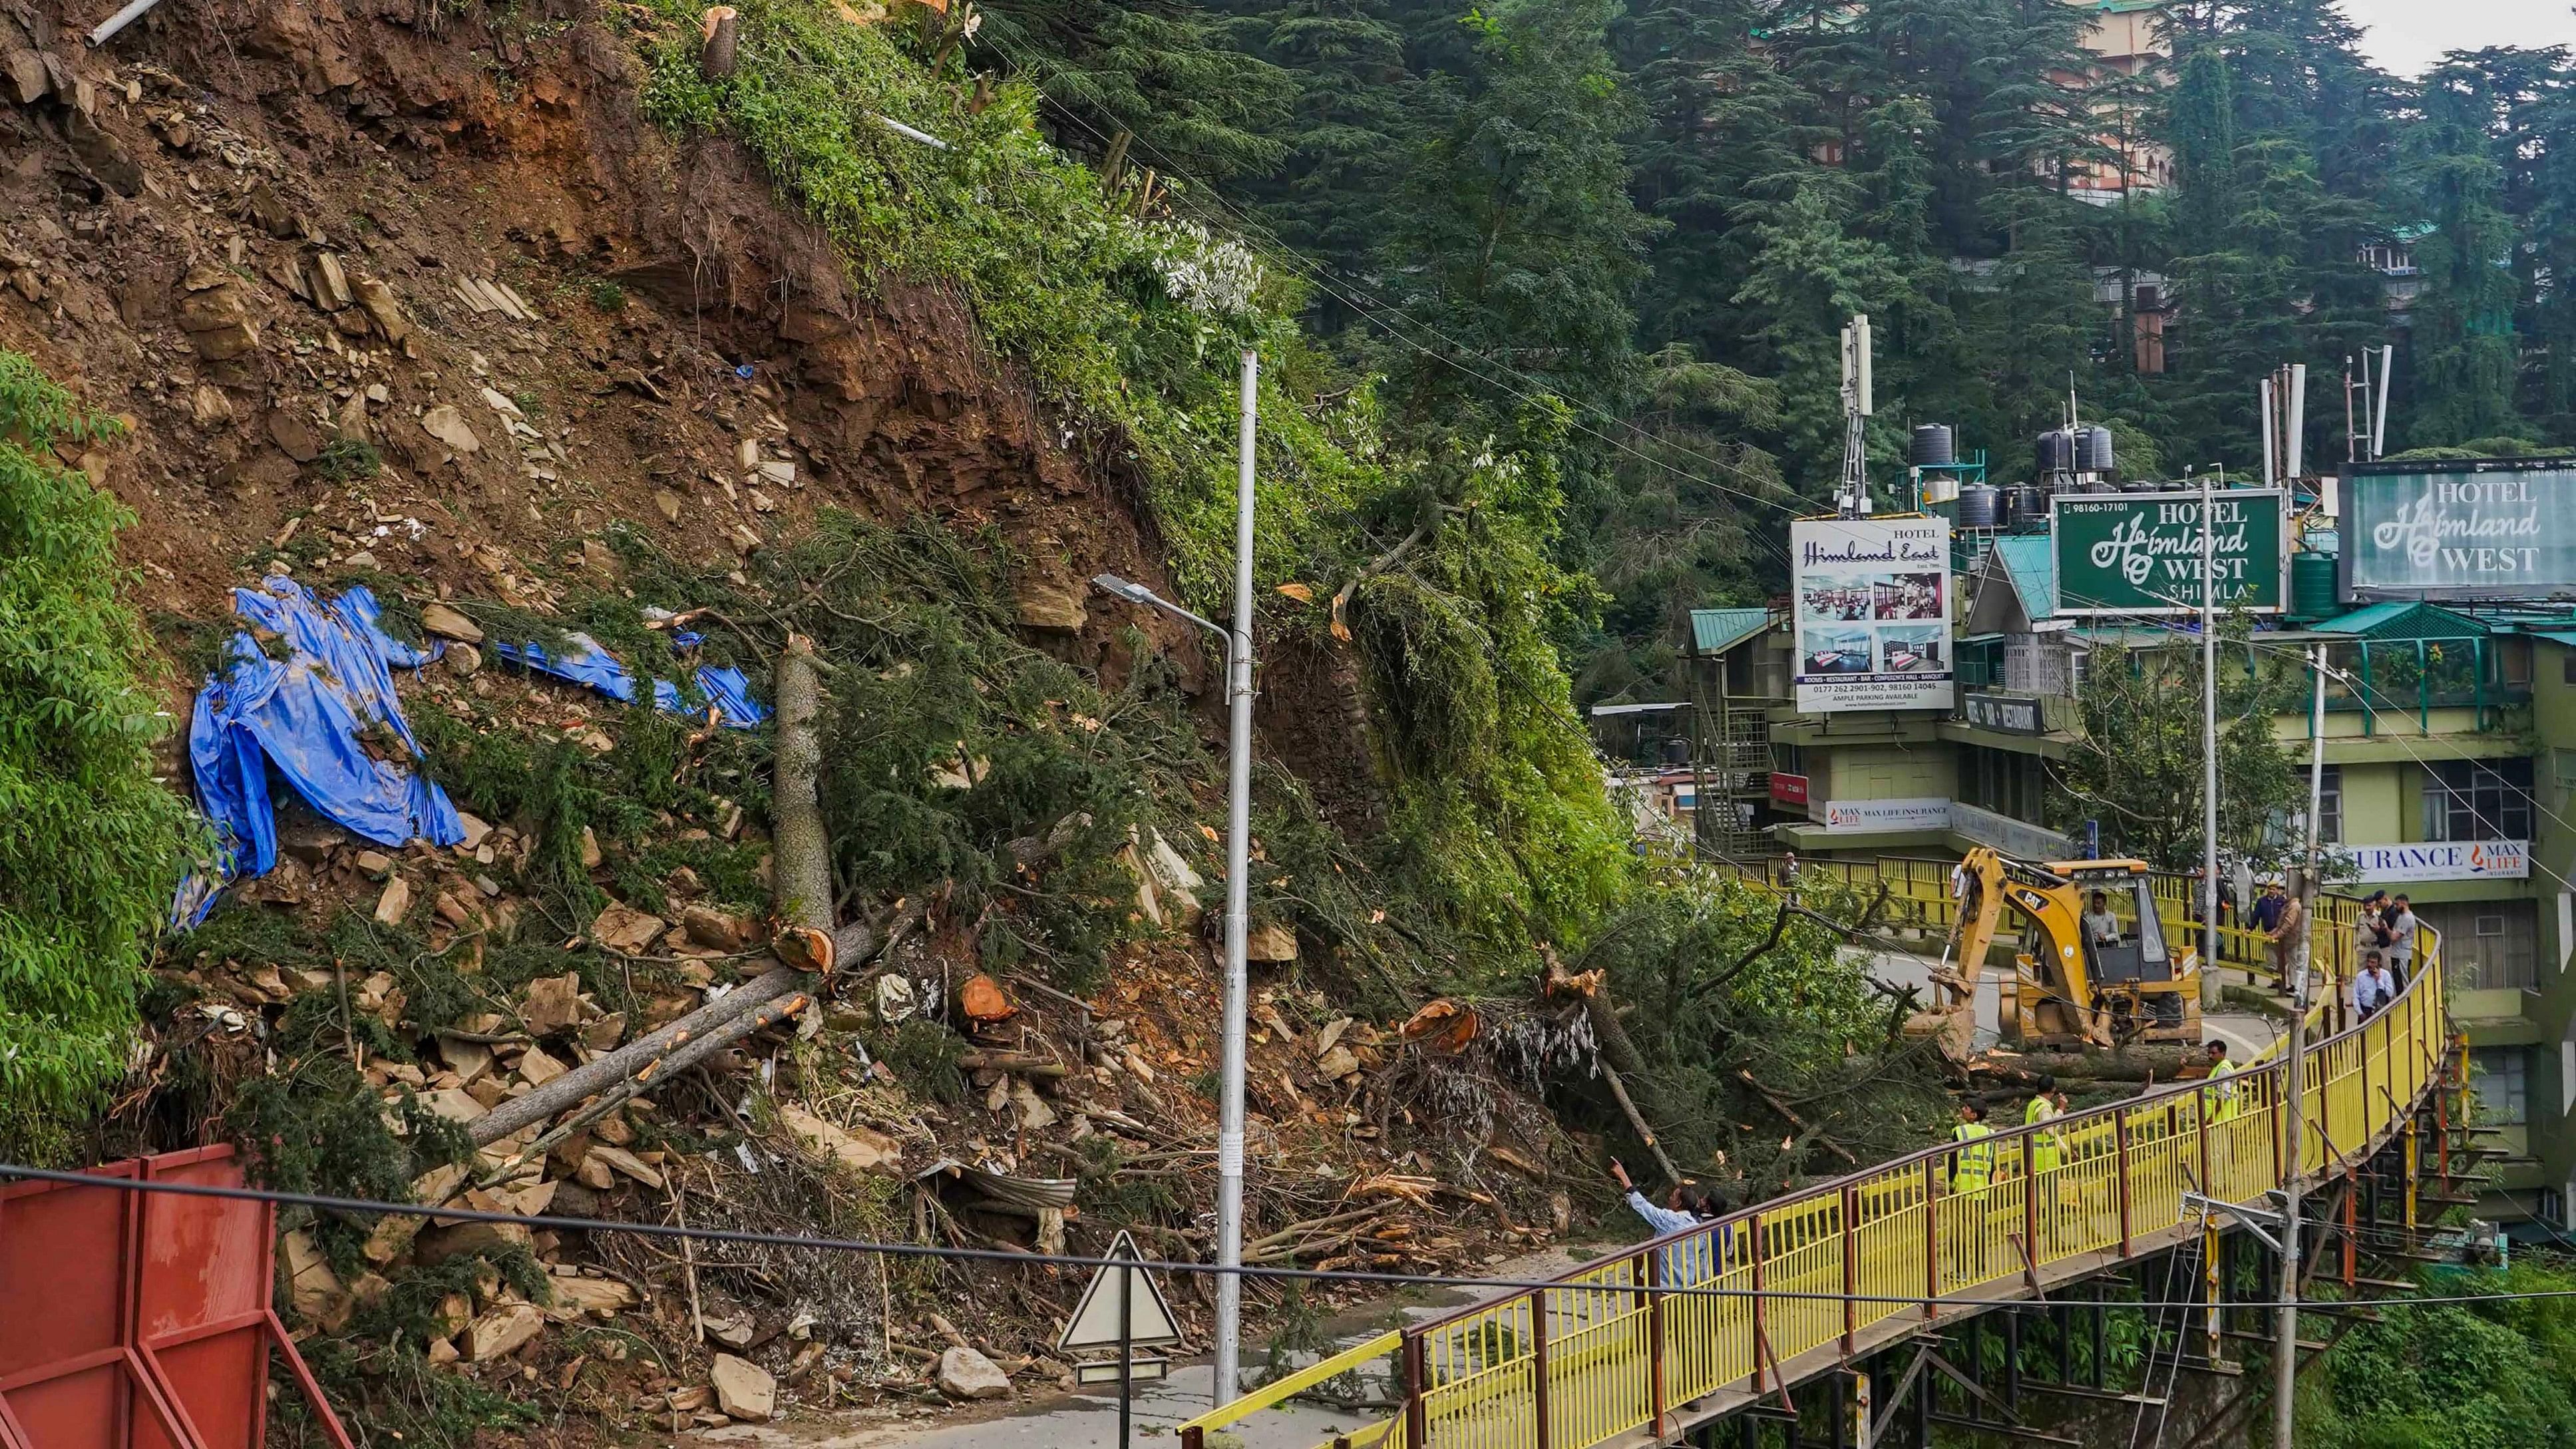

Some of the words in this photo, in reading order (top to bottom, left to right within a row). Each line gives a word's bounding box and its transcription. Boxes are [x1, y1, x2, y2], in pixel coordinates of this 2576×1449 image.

[2437, 482, 2538, 503] HOTEL
[2073, 503, 2128, 513] 98160-17101
[1894, 529, 1939, 539] HOTEL
[2374, 493, 2541, 567] Himland
[1804, 540, 1896, 567] Himland
[1900, 542, 1940, 562] East
[2440, 548, 2539, 572] WEST
[1850, 684, 1887, 693] 2901-902,
[1839, 807, 1861, 816] MAX
[2487, 843, 2521, 856] MAX
[2487, 856, 2522, 869] LIFE
[2024, 892, 2041, 910] CAT
